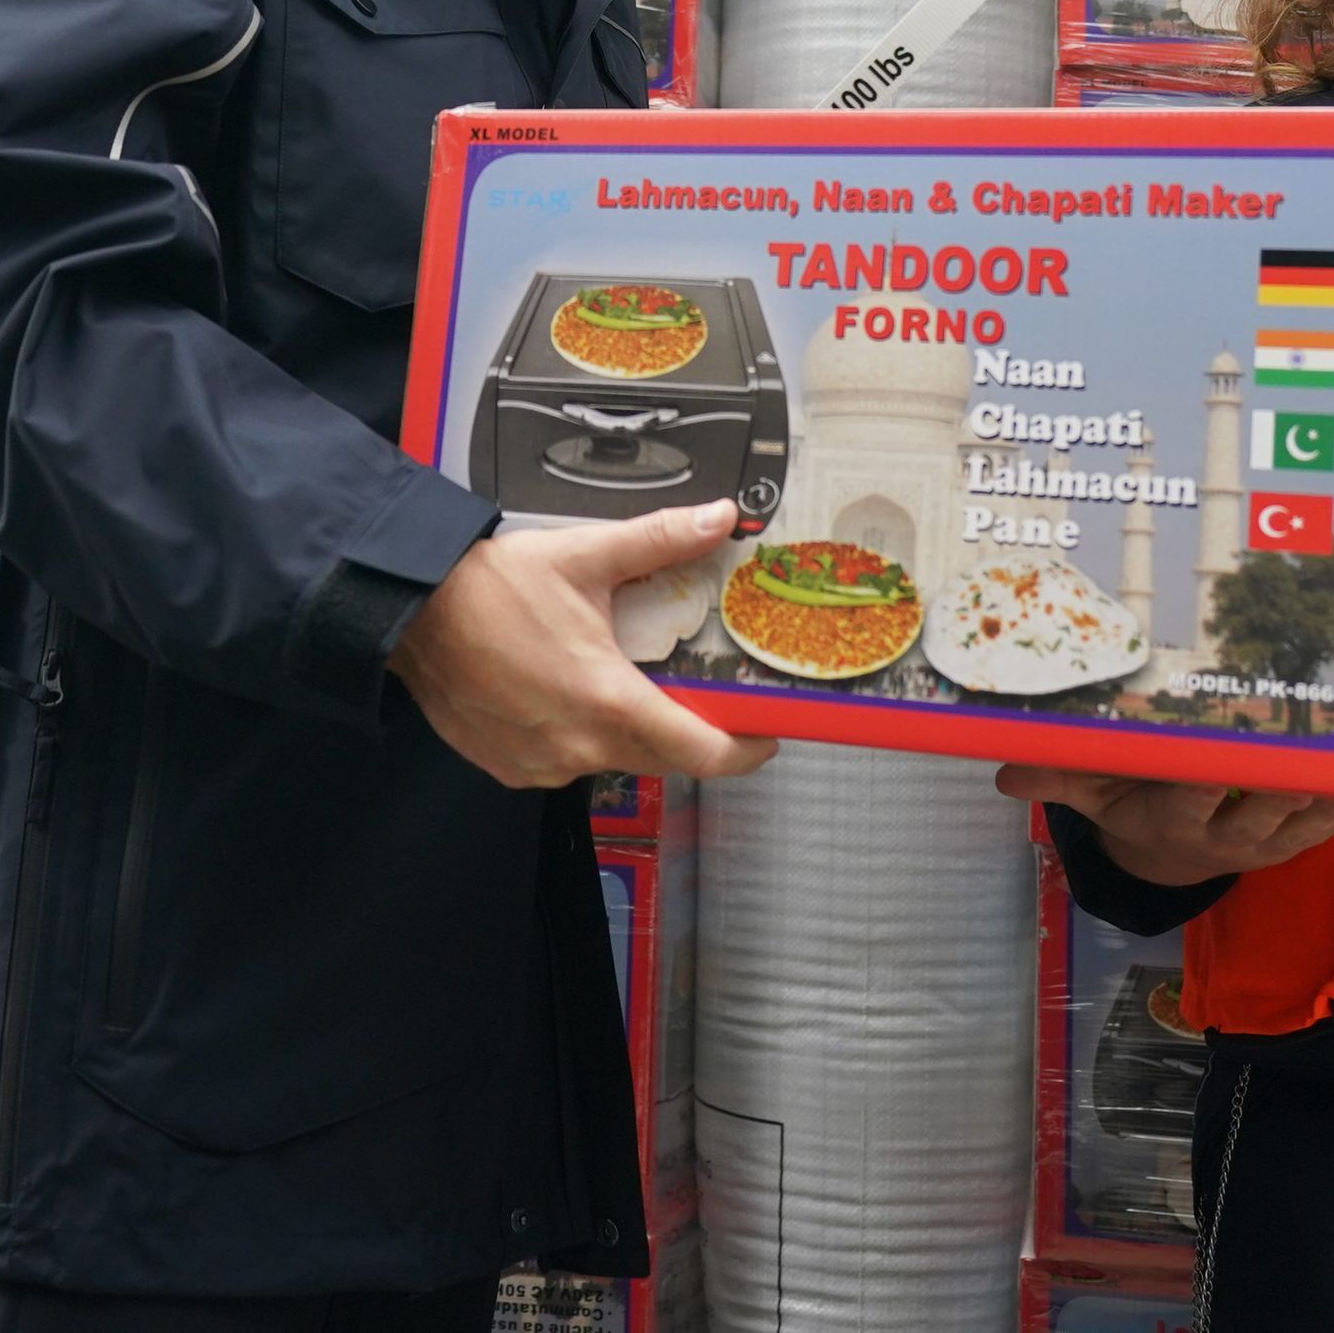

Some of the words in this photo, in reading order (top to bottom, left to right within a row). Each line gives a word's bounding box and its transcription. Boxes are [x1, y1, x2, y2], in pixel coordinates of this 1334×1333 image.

[867, 45, 915, 87] lbs
[470, 127, 493, 142] XL
[496, 127, 560, 142] MODEL
[597, 177, 800, 217] Lahmacun,
[812, 180, 913, 215] Naan
[927, 182, 957, 213] &
[971, 180, 1133, 224] Chapati
[1147, 183, 1284, 223] Maker
[767, 241, 1070, 298] TANDOOR
[833, 305, 1007, 346] FORNO
[973, 348, 1085, 390] Naan
[970, 401, 1147, 452] Chapati
[966, 454, 1199, 508] Lahmacun
[962, 505, 1082, 549] Pane
[1169, 671, 1251, 698] MODEL:
